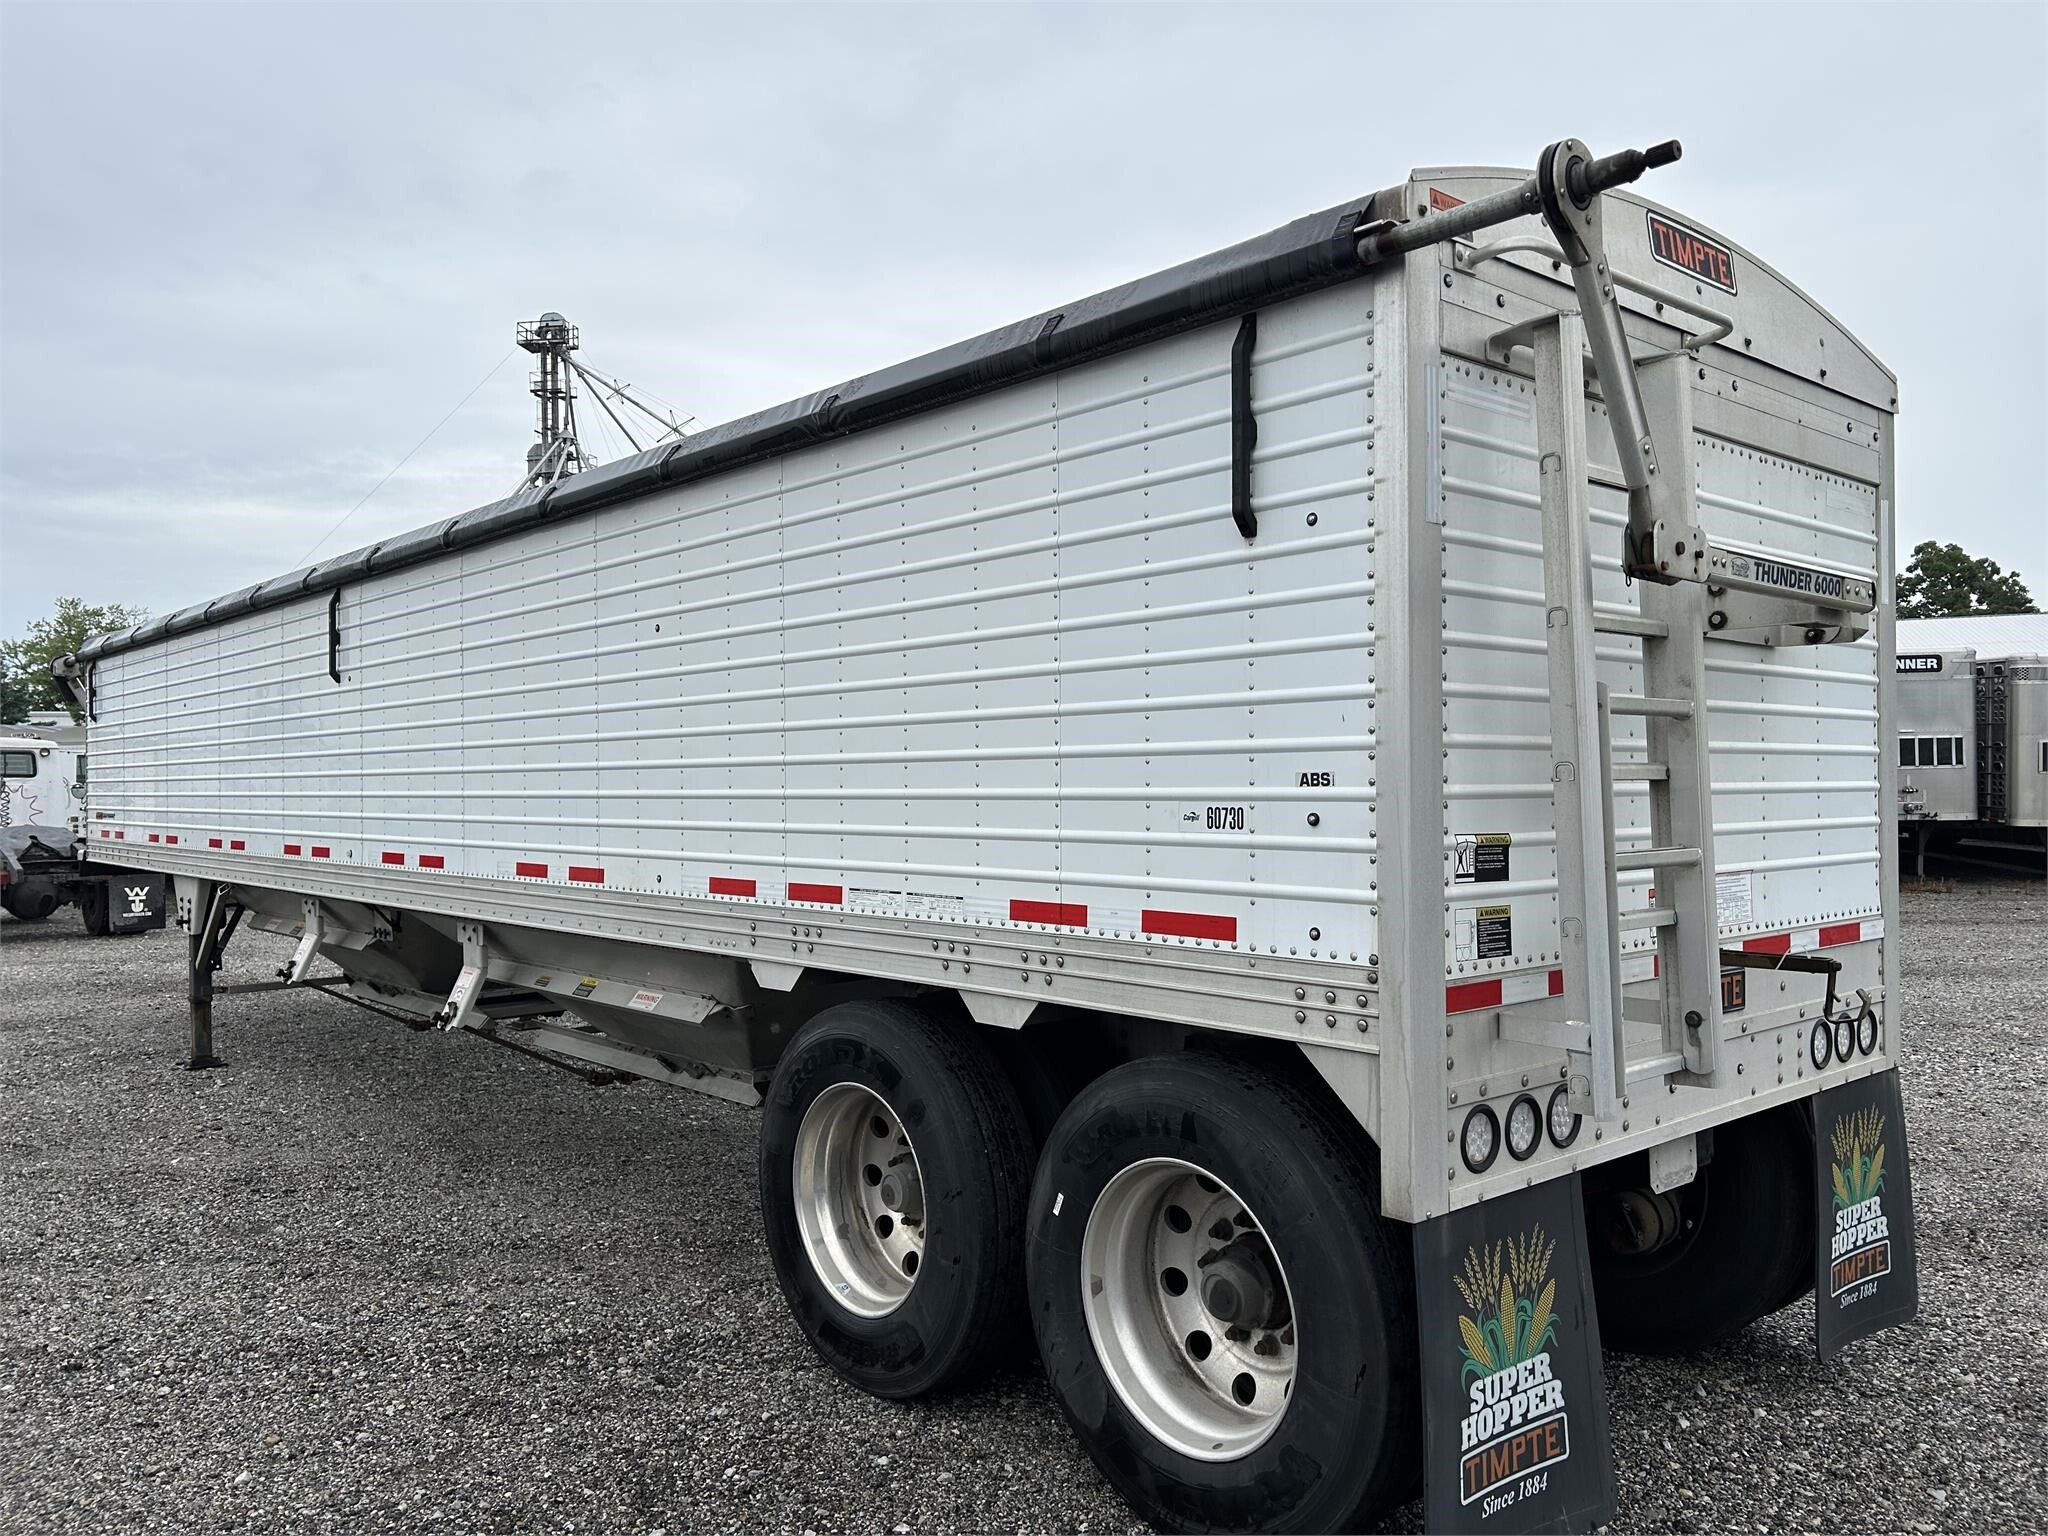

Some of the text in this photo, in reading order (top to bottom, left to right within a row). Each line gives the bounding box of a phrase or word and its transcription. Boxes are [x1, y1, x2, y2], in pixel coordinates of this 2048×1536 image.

[1653, 222, 1731, 286] TIMPTE
[1754, 561, 1812, 592] THUNDER
[1814, 574, 1841, 597] 6000
[1299, 772, 1331, 787] ABS
[1206, 806, 1244, 830] 60730
[1484, 835, 1509, 844] WARNING
[1485, 907, 1509, 917] WARNING
[1836, 1196, 1882, 1233] SUPER
[1832, 1215, 1889, 1259] HOPPER
[1833, 1246, 1886, 1290] TIMPTE
[1840, 1281, 1878, 1309] Since 1884
[1469, 1352, 1553, 1413] SUPER
[1461, 1379, 1566, 1452] HOPPER
[1465, 1421, 1562, 1495] TIMPTE
[1481, 1471, 1548, 1519] Since 1884
